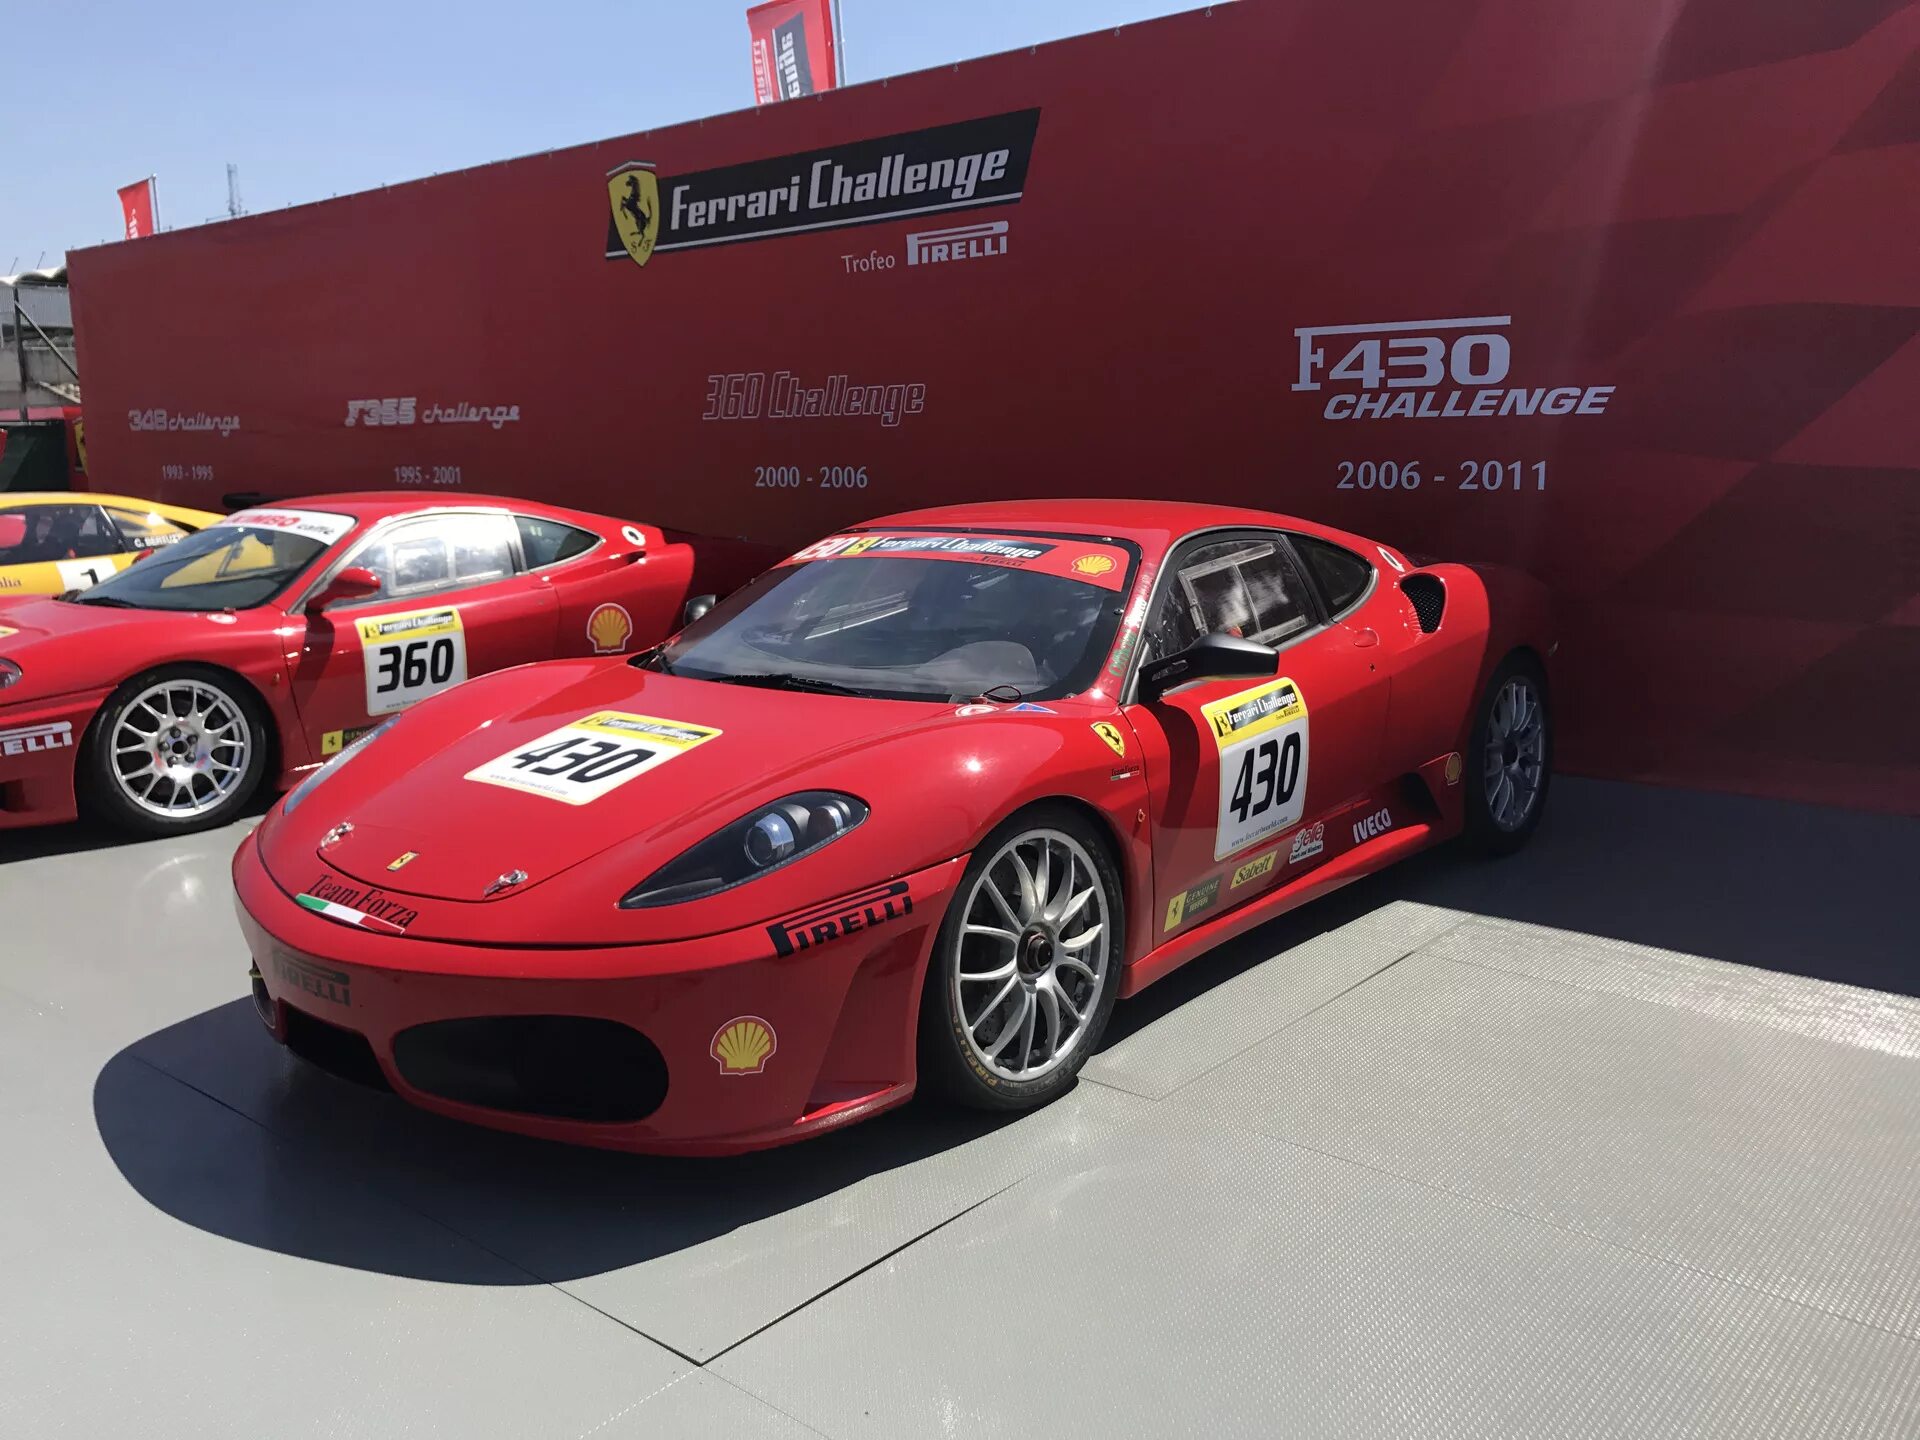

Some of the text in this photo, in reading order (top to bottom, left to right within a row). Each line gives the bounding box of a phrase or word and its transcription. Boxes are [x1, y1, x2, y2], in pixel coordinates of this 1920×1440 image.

[670, 149, 1010, 231] Ferrari Challenge
[841, 220, 1009, 274] Trofeo PIRELLI
[1291, 315, 1511, 391] F430
[421, 402, 521, 429] challenge
[702, 371, 926, 427] 360 Challenge
[1323, 386, 1616, 420] CHALLENGE
[168, 412, 241, 437] challenge
[161, 465, 184, 481] 1993
[191, 465, 214, 481] 1995
[394, 466, 422, 484] 1995
[433, 466, 461, 485] 2001
[754, 466, 801, 487] 2000
[819, 466, 868, 488] 2006
[1336, 460, 1421, 490] 2006
[1458, 460, 1548, 491] 2011
[869, 537, 948, 550] Ferrari
[940, 537, 1043, 559] Challenge
[377, 638, 454, 694] 360
[1227, 692, 1296, 725] Ferrari Challenge
[0, 721, 73, 757] ELLI
[512, 737, 657, 783] 430
[1230, 732, 1301, 823] 430
[1353, 807, 1392, 844] IVECO
[306, 874, 419, 928] Team Forza
[766, 881, 914, 959] PIRELLI
[271, 945, 351, 1006] PIRELLI
